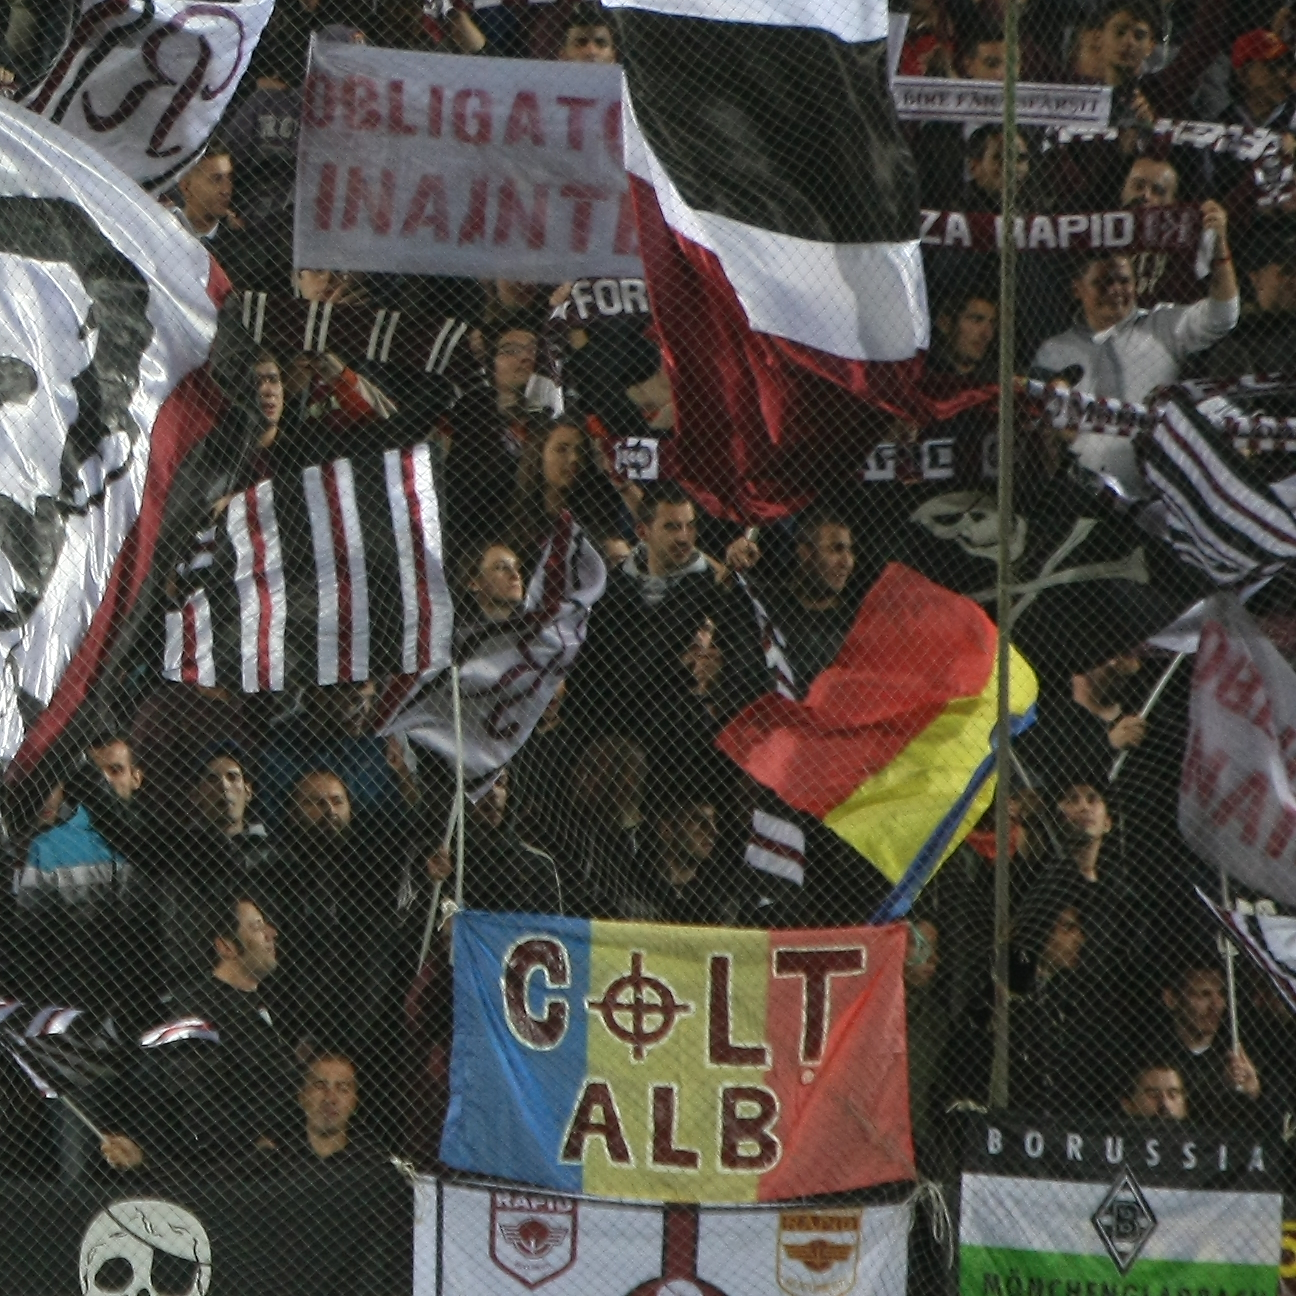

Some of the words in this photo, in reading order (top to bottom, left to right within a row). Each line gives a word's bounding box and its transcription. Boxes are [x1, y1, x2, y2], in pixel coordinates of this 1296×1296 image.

[572, 280, 649, 322] FOR
[558, 1078, 784, 1176] ALB
[985, 1127, 1266, 1172] BORUSSIA
